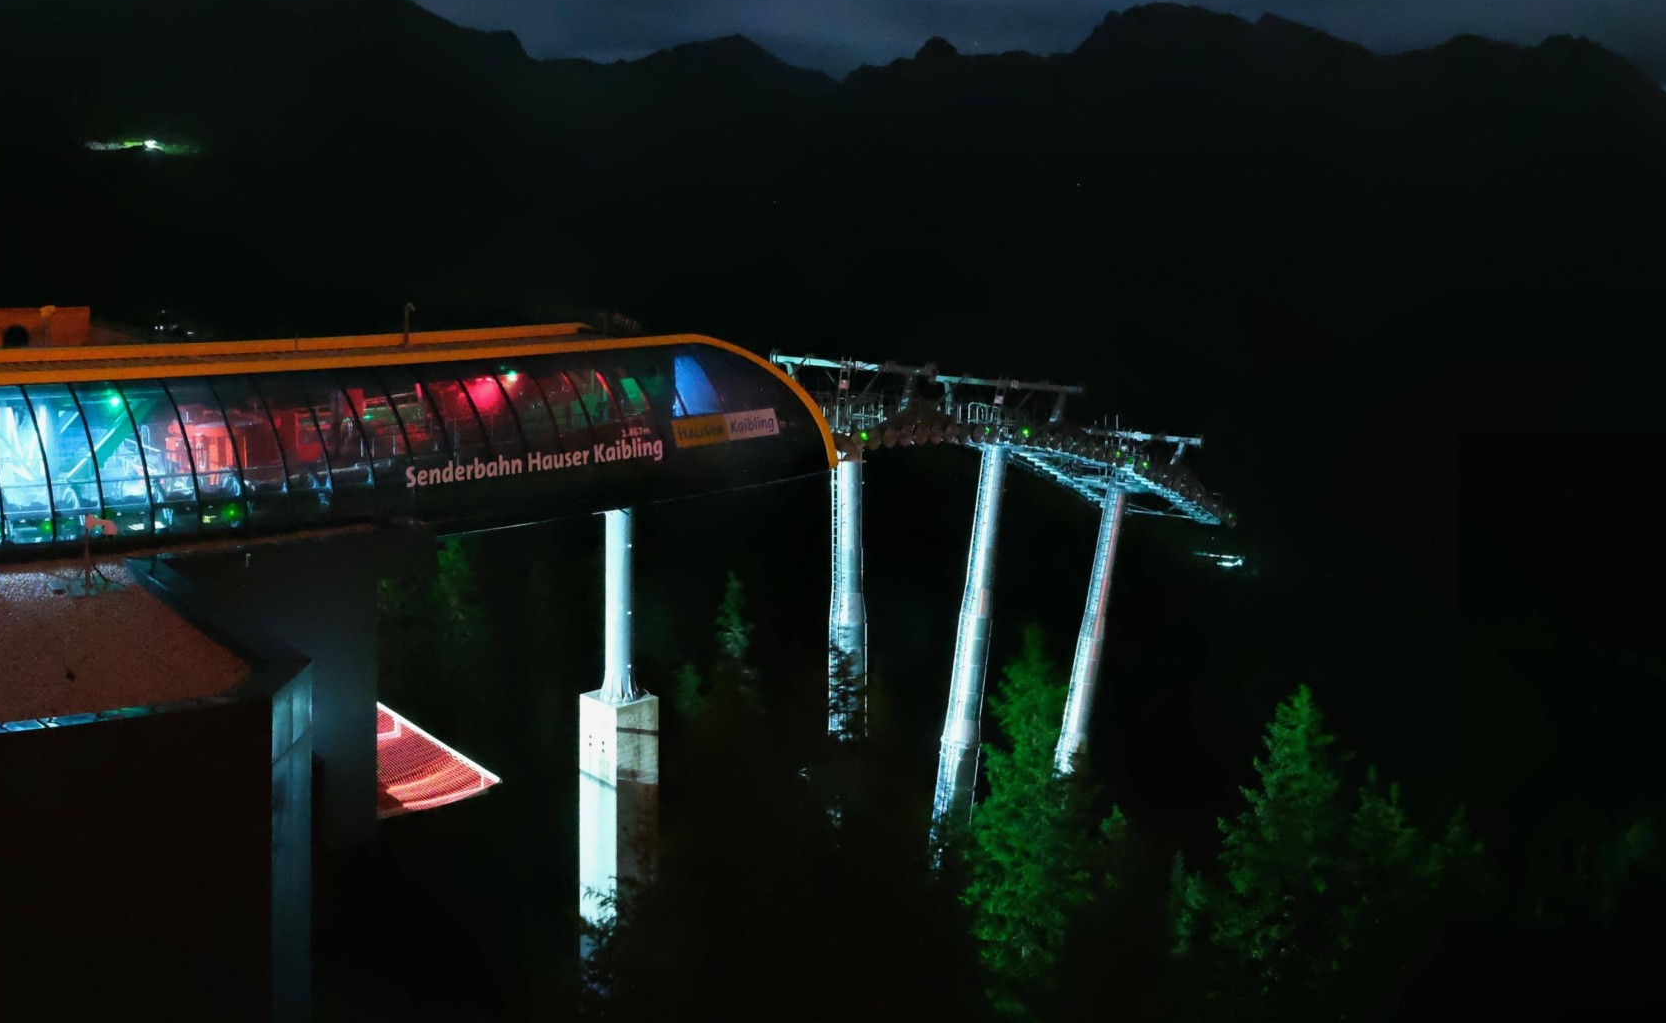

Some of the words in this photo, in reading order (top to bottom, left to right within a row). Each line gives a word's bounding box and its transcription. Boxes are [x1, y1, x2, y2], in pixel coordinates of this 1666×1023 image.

[730, 416, 775, 433] Kaibling
[406, 454, 523, 488] Senderbahn
[527, 449, 590, 473] Hauser
[593, 437, 664, 463] Kaibling
